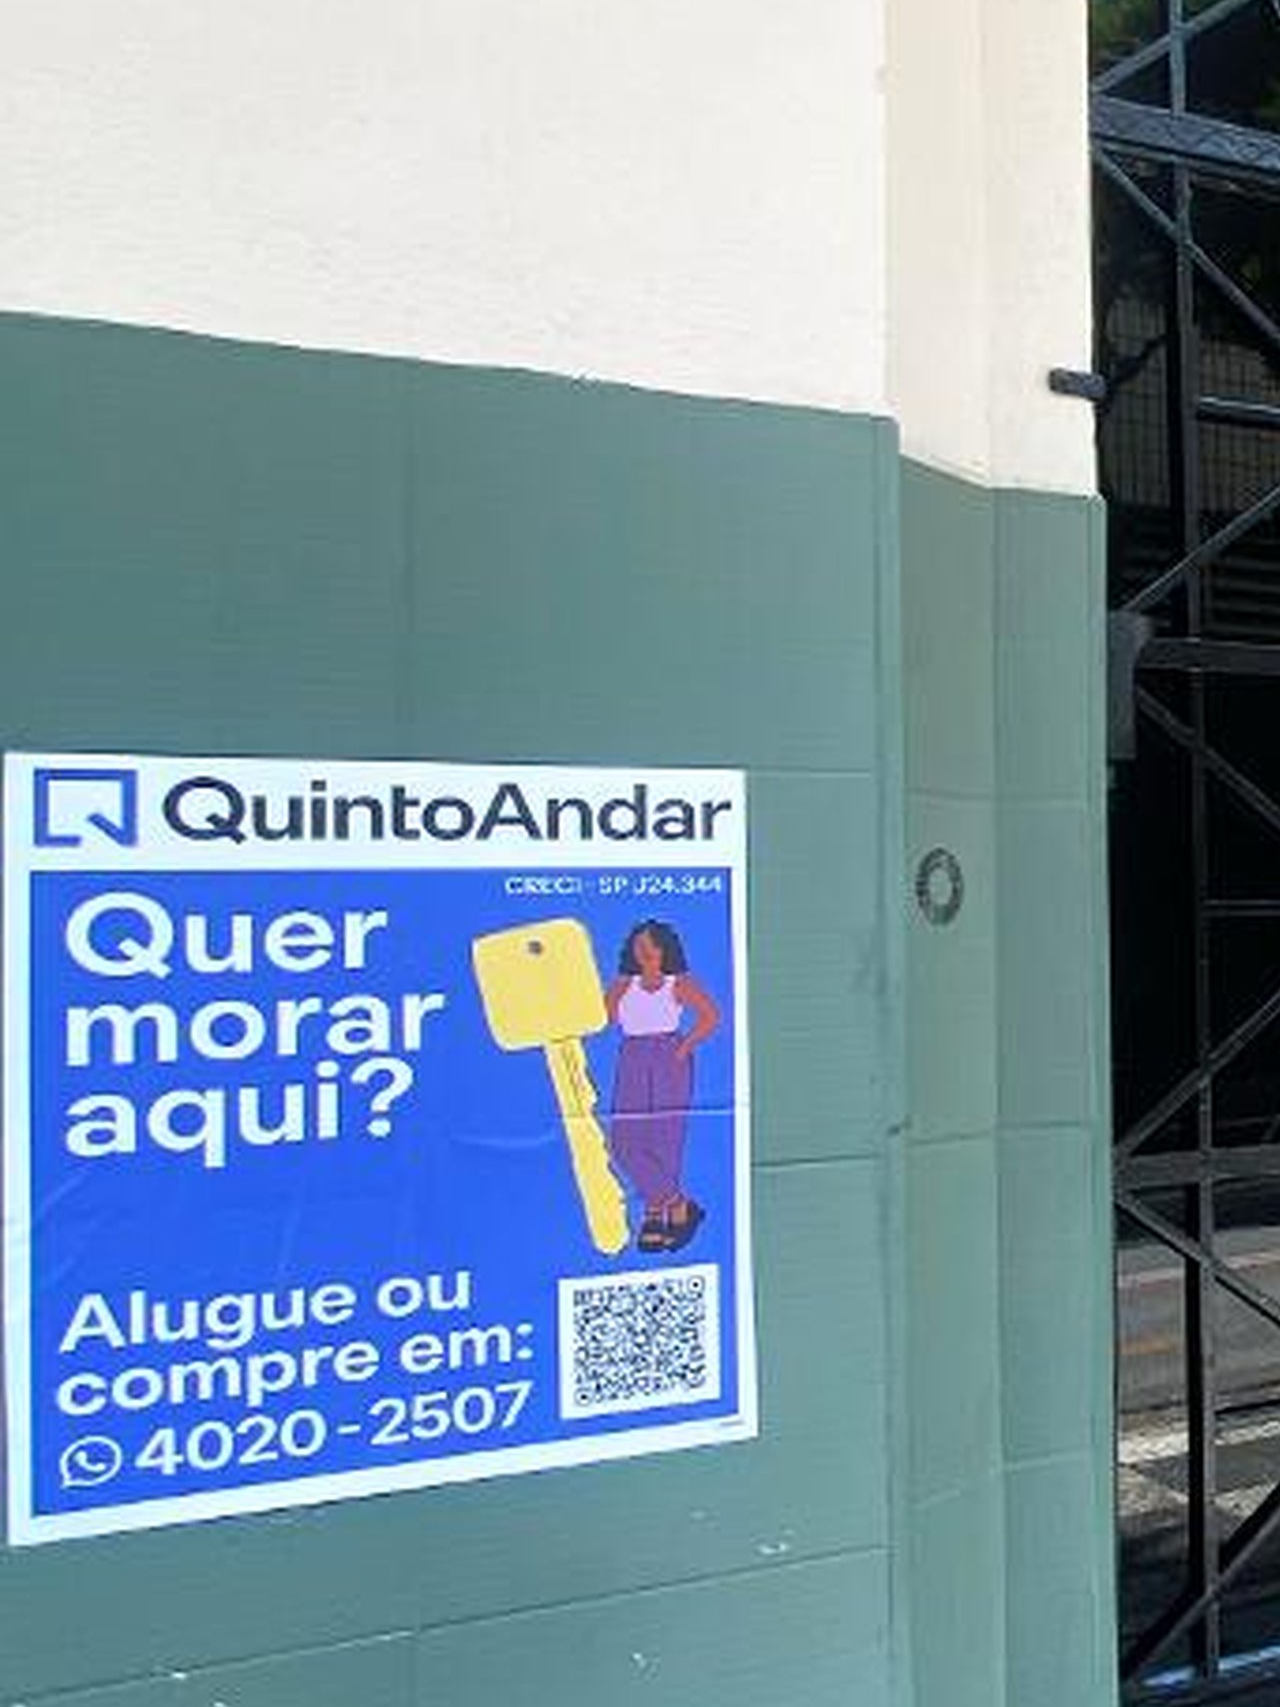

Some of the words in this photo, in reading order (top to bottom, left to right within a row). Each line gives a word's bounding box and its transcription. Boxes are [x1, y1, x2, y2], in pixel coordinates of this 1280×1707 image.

[162, 775, 733, 846] QuintoAndar
[65, 892, 388, 979] Quer
[65, 992, 446, 1067] morar
[65, 1057, 414, 1168] aqui?
[59, 1284, 357, 1353] Alugue
[376, 1270, 471, 1318] ou
[57, 1340, 379, 1416] compre
[398, 1323, 533, 1374] em:
